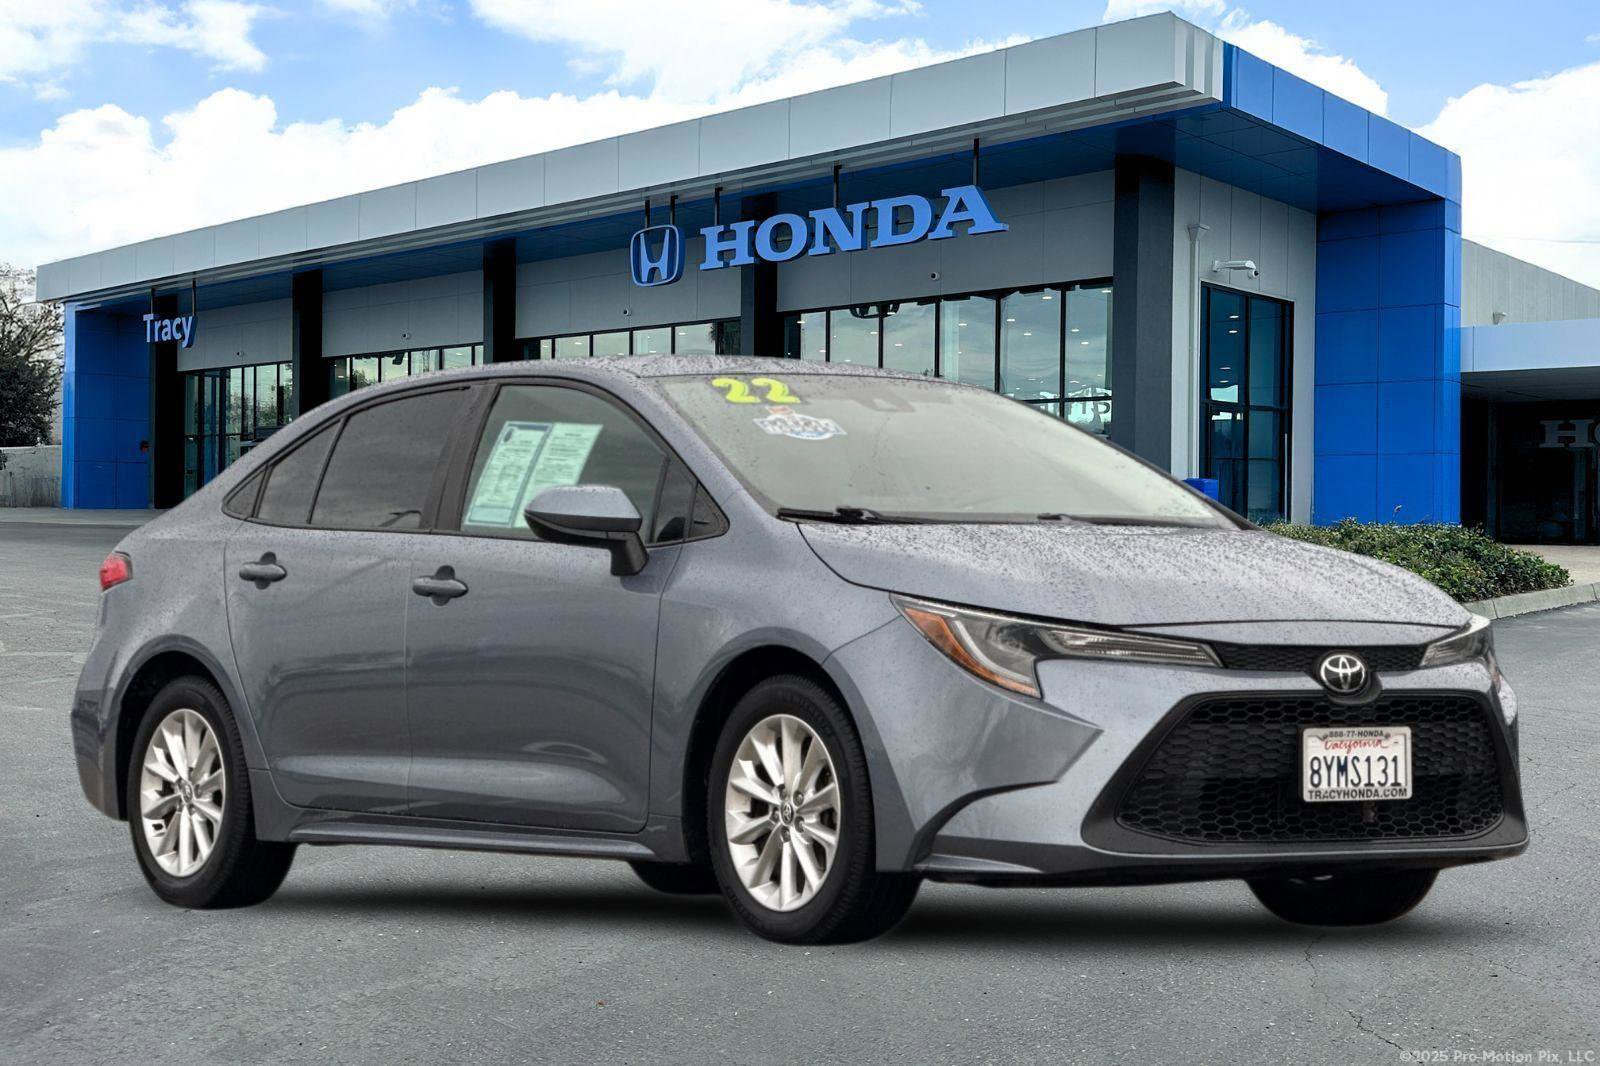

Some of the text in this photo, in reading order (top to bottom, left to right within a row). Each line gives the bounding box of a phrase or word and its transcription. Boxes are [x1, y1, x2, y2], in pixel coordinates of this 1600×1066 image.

[700, 184, 1009, 271] HONDA
[143, 313, 193, 348] Tracy
[711, 377, 800, 404] 22
[1539, 419, 1600, 448] H
[1310, 755, 1402, 788] 8YMS131
[1308, 788, 1407, 799] TRACYHONDA.COM
